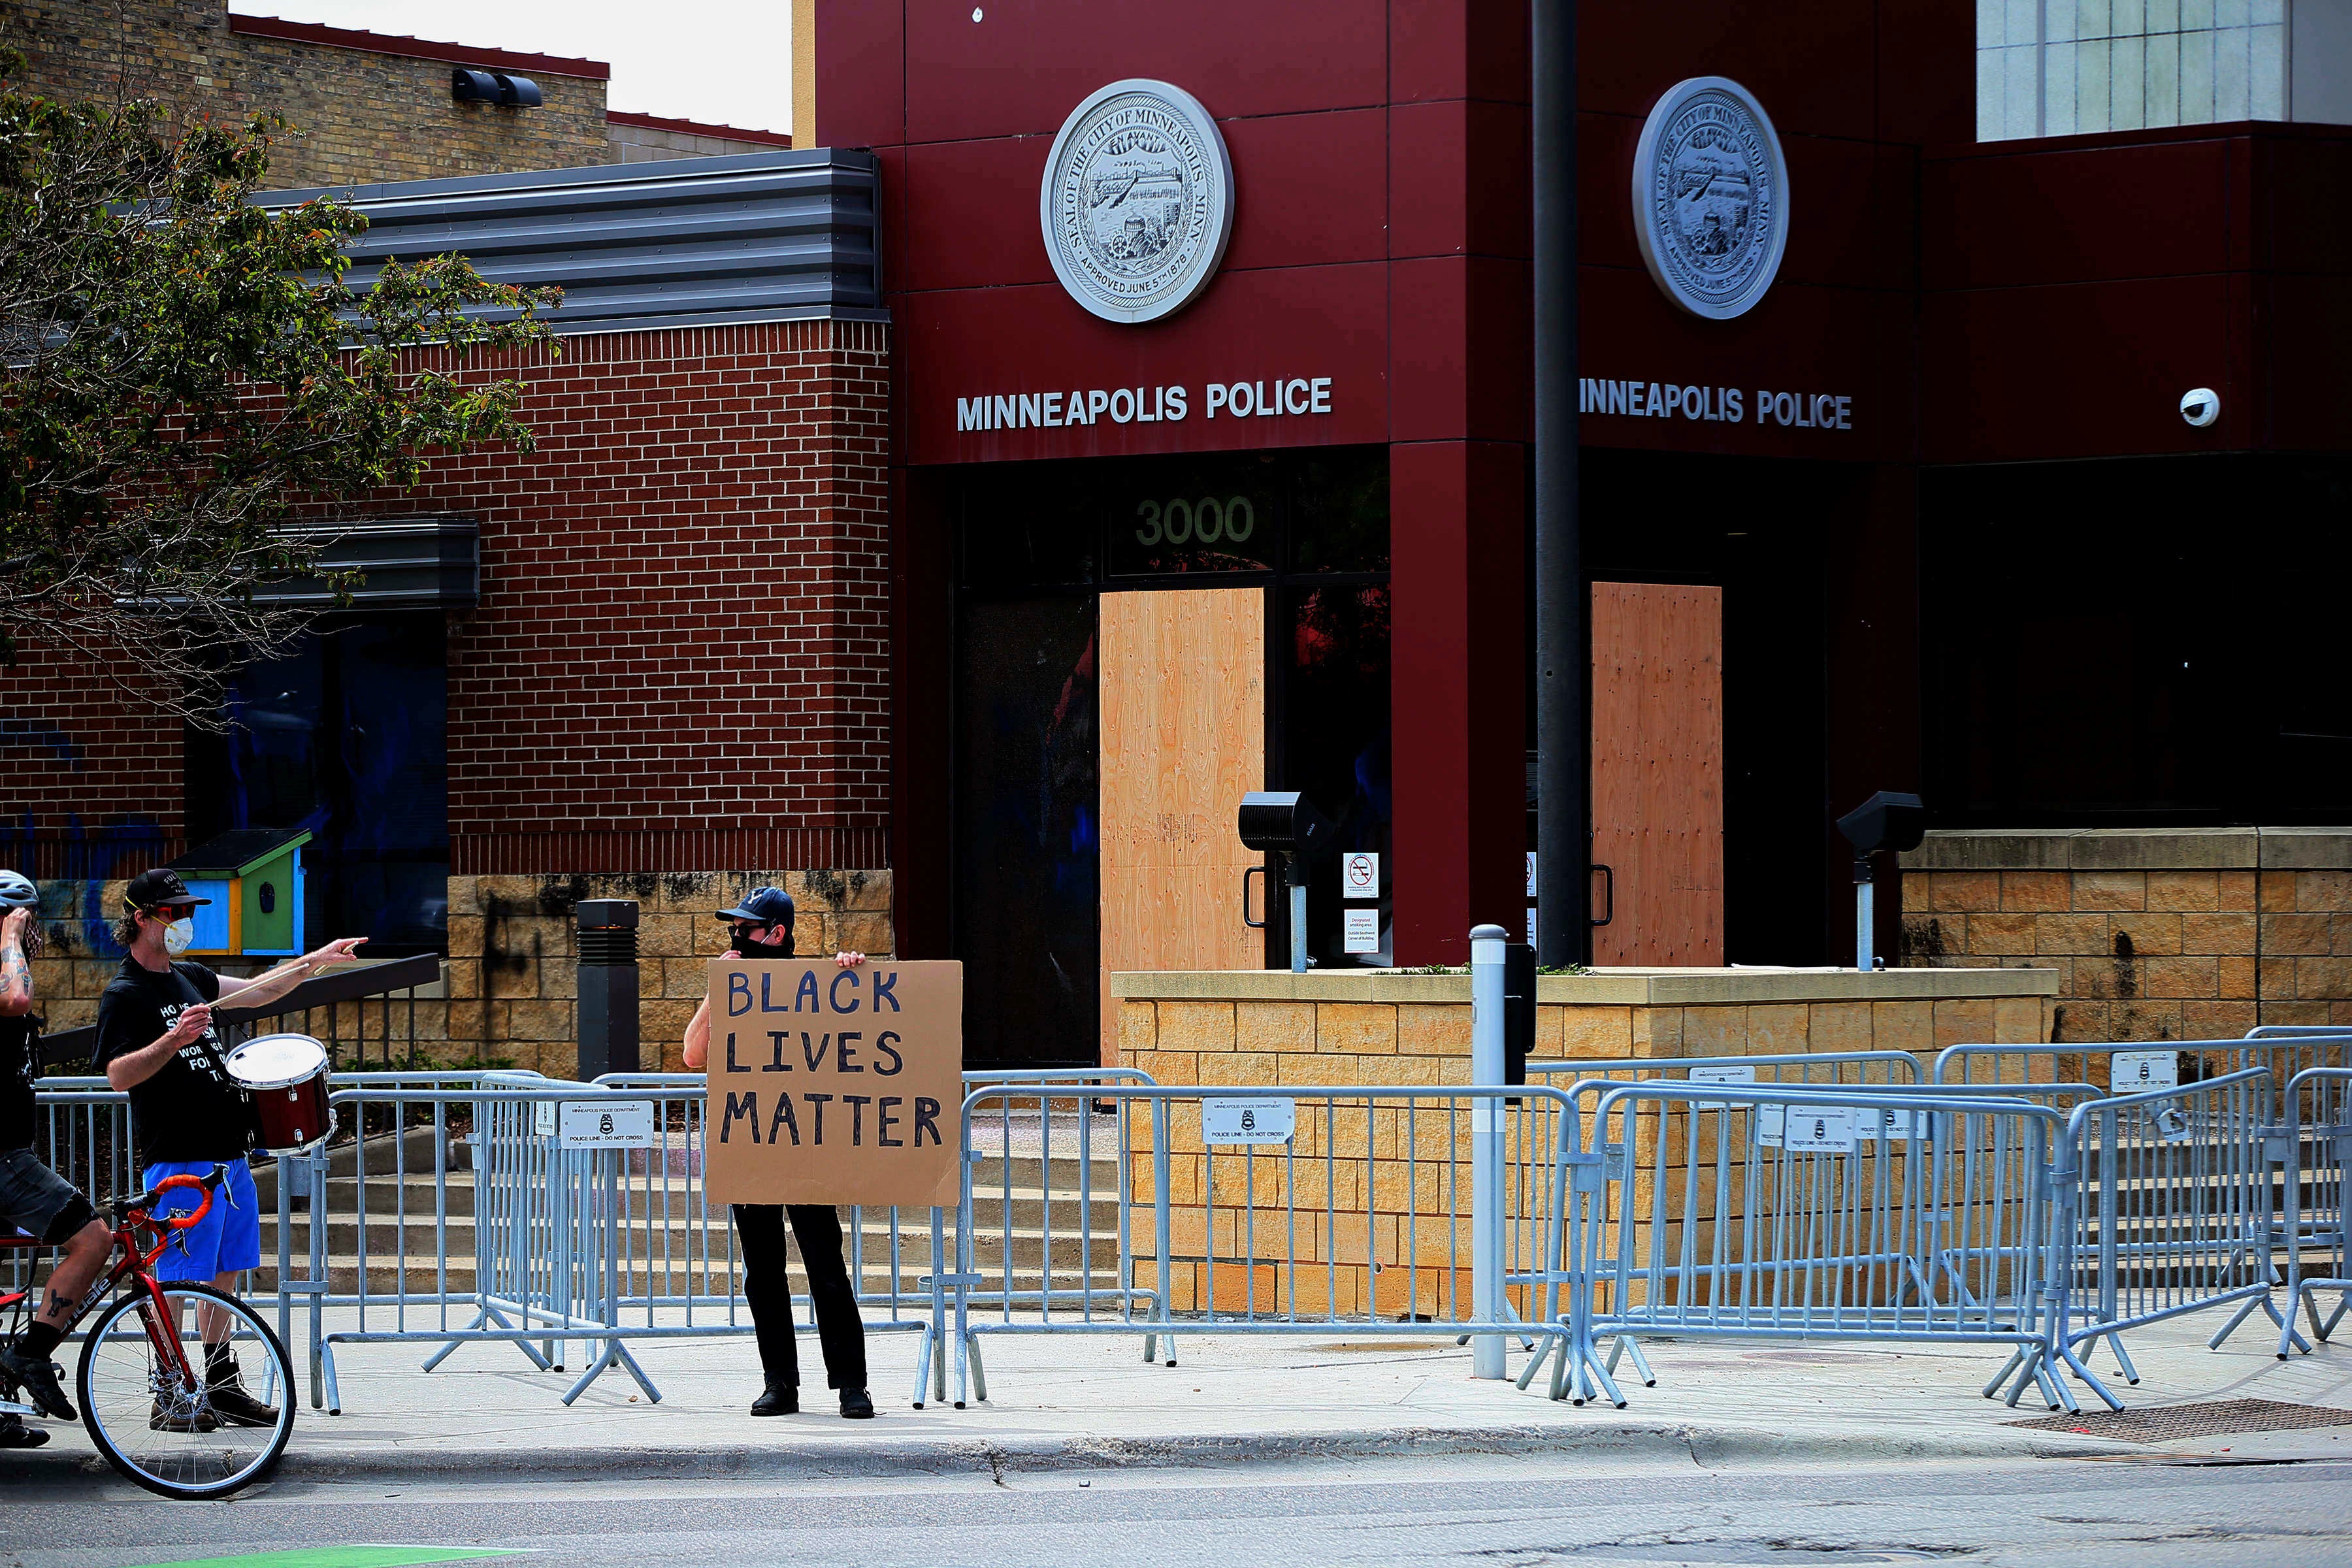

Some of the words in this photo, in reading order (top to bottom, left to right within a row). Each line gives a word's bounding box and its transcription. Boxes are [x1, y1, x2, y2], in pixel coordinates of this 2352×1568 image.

[1088, 116, 1114, 146] CITY
[1116, 110, 1132, 126] OF
[1674, 113, 1697, 137] CITY
[1697, 106, 1711, 122] OF
[1109, 132, 1124, 148] EN
[1127, 131, 1161, 143] AVANT
[1070, 146, 1090, 178] THE
[1066, 181, 1077, 204] OF
[1066, 206, 1082, 249] SEAL
[1080, 257, 1126, 293] APPROVED
[1127, 281, 1151, 294] JUNE
[1168, 255, 1188, 280] 1878
[956, 385, 1188, 431] MINNEAPOLIS
[1206, 377, 1332, 419] POLICE
[1578, 378, 1744, 423] INNEAPOLIS
[1757, 390, 1852, 429] POLICE
[1135, 495, 1254, 546] 3000
[163, 874, 177, 885] FUL
[727, 970, 902, 1017] BLACK
[726, 1030, 904, 1077] LIVES
[720, 1090, 943, 1148] MATTER
